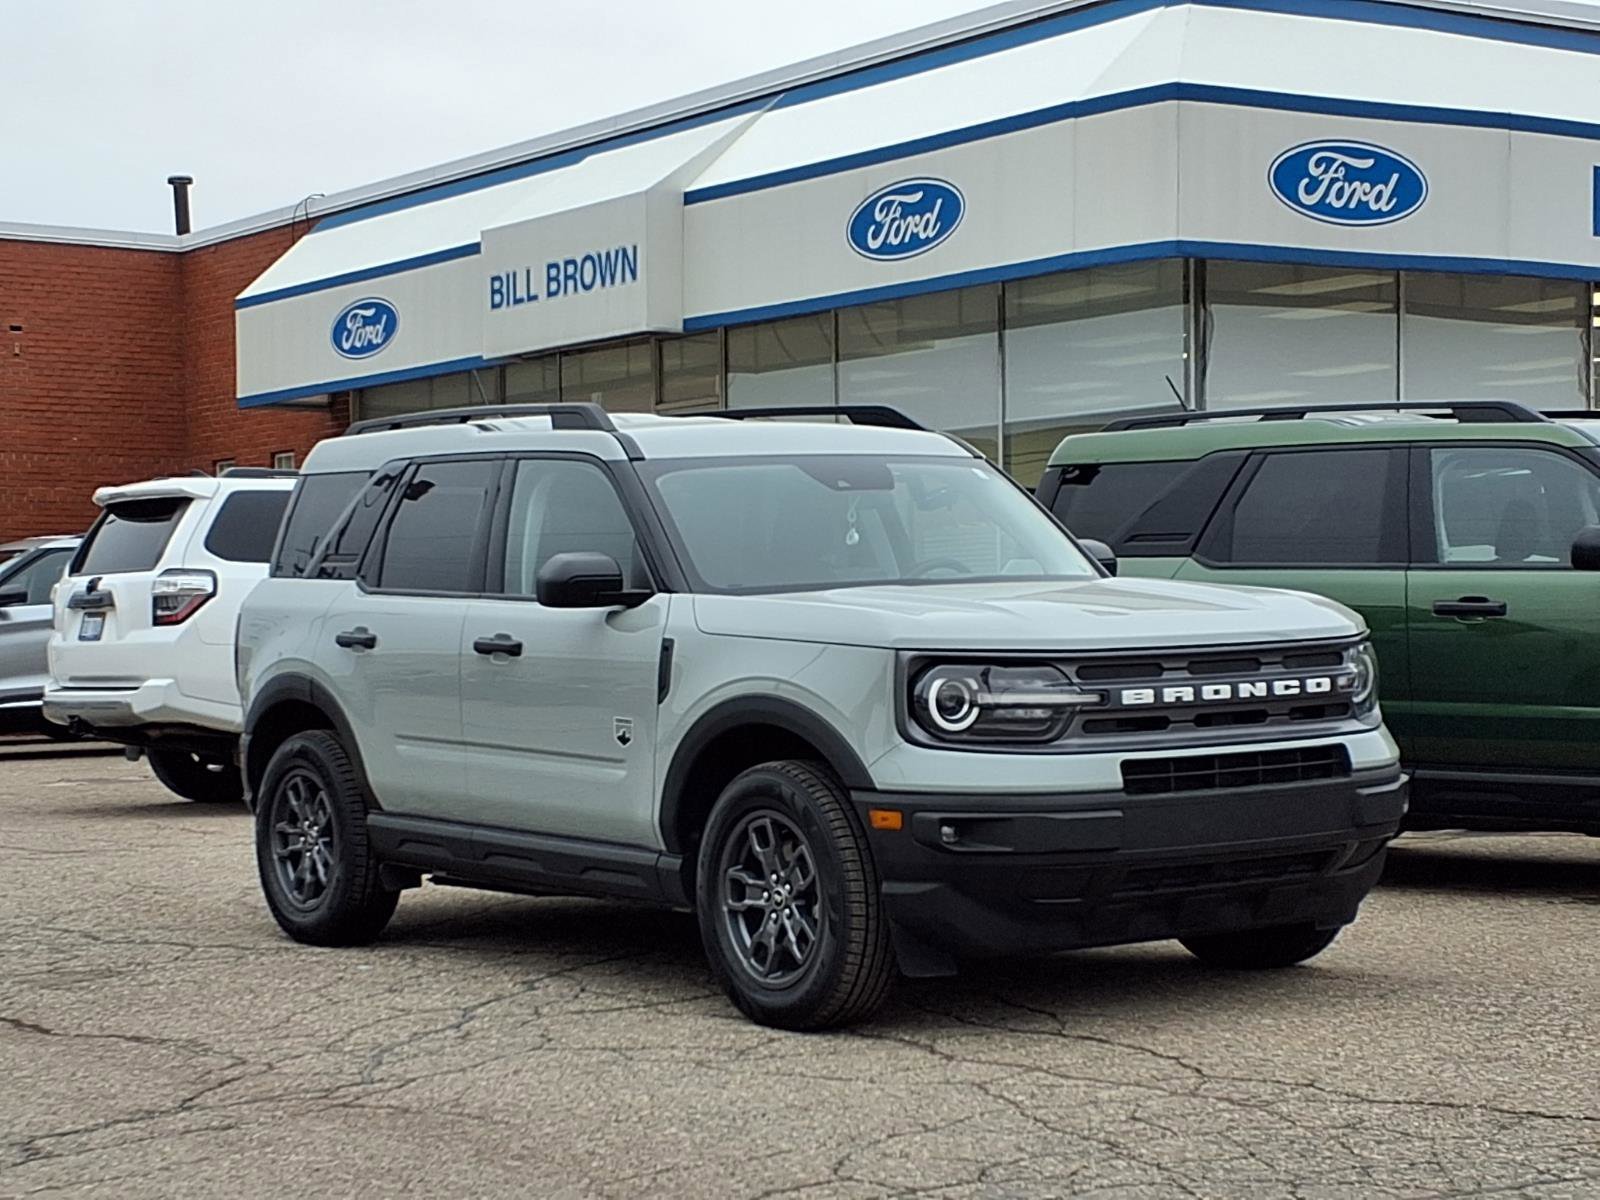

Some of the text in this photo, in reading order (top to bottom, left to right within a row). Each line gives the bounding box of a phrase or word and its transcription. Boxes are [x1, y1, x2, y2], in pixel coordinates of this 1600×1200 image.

[1298, 151, 1399, 212] Ford
[867, 190, 942, 249] Ford
[490, 245, 638, 310] BILL BROWN
[342, 307, 387, 350] Ford
[1121, 677, 1331, 705] BRONCO
